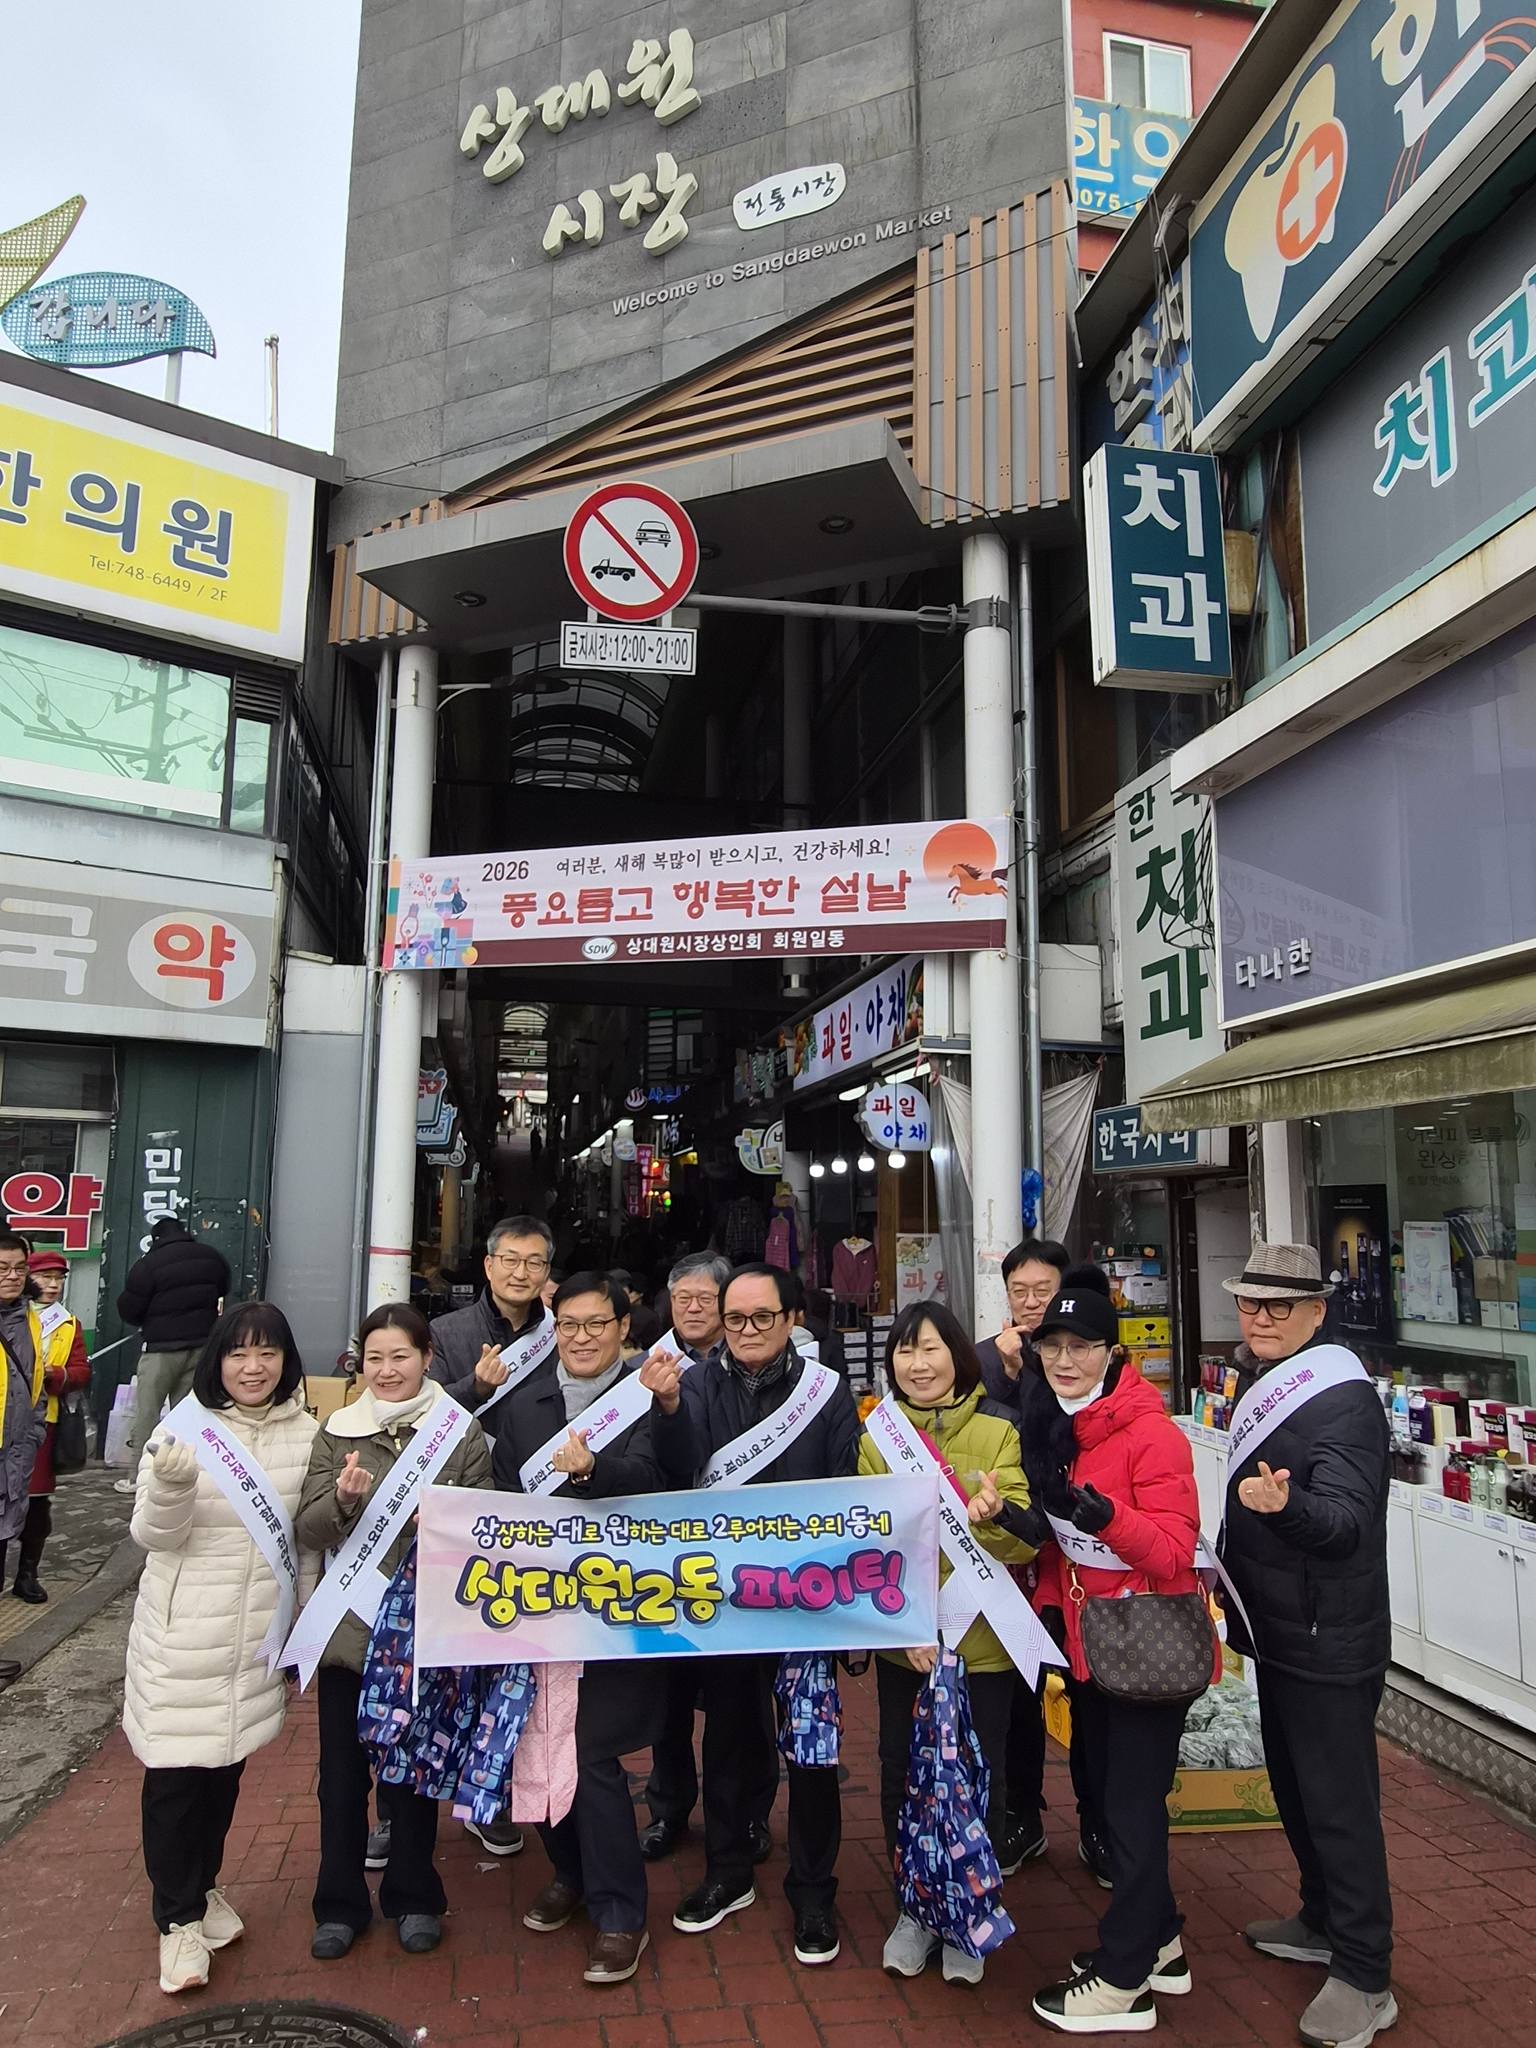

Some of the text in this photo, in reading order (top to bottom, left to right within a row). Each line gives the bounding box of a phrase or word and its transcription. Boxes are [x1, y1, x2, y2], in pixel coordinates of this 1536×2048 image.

[460, 27, 702, 184] 상대원
[542, 152, 699, 257] 시장
[742, 170, 838, 218] 전통시장
[612, 204, 953, 317] Welcome to Sangdaewon Market
[29, 289, 176, 342] 갑니다
[89, 554, 192, 594] Tel:748-6449
[210, 587, 228, 602] 2F
[1121, 462, 1221, 662] 치과
[481, 860, 529, 882] 2026
[614, 853, 646, 873] 새해
[652, 848, 701, 871] 복많이
[792, 838, 890, 861] 건강하세요!
[501, 870, 912, 929] 풍요롭고 행복한 설날
[586, 942, 613, 956] SDW
[626, 929, 846, 956] 상대원시장상인회 회원일동
[1136, 828, 1209, 1041] 치과
[153, 922, 236, 1002] 약
[1234, 936, 1311, 988] 다나한
[871, 1094, 917, 1118] 과일
[883, 1121, 927, 1148] 야채
[1, 1171, 105, 1251] 약
[1059, 1299, 1076, 1313] H
[775, 1401, 807, 1438] 소비가
[1252, 1368, 1315, 1424] 물가안정에
[200, 1427, 258, 1494] 물가안정에
[251, 1492, 283, 1535] 다함께
[723, 1433, 776, 1476] 지역경제
[339, 1408, 459, 1592] 물가안정에 다함께 참여합시다
[472, 1505, 892, 1549] 상상하는 대로 원하는 대로 2루어지는 우리 동네
[938, 1506, 994, 1582] 참여합시다
[454, 1548, 906, 1629] 상대원2동 파이팅
